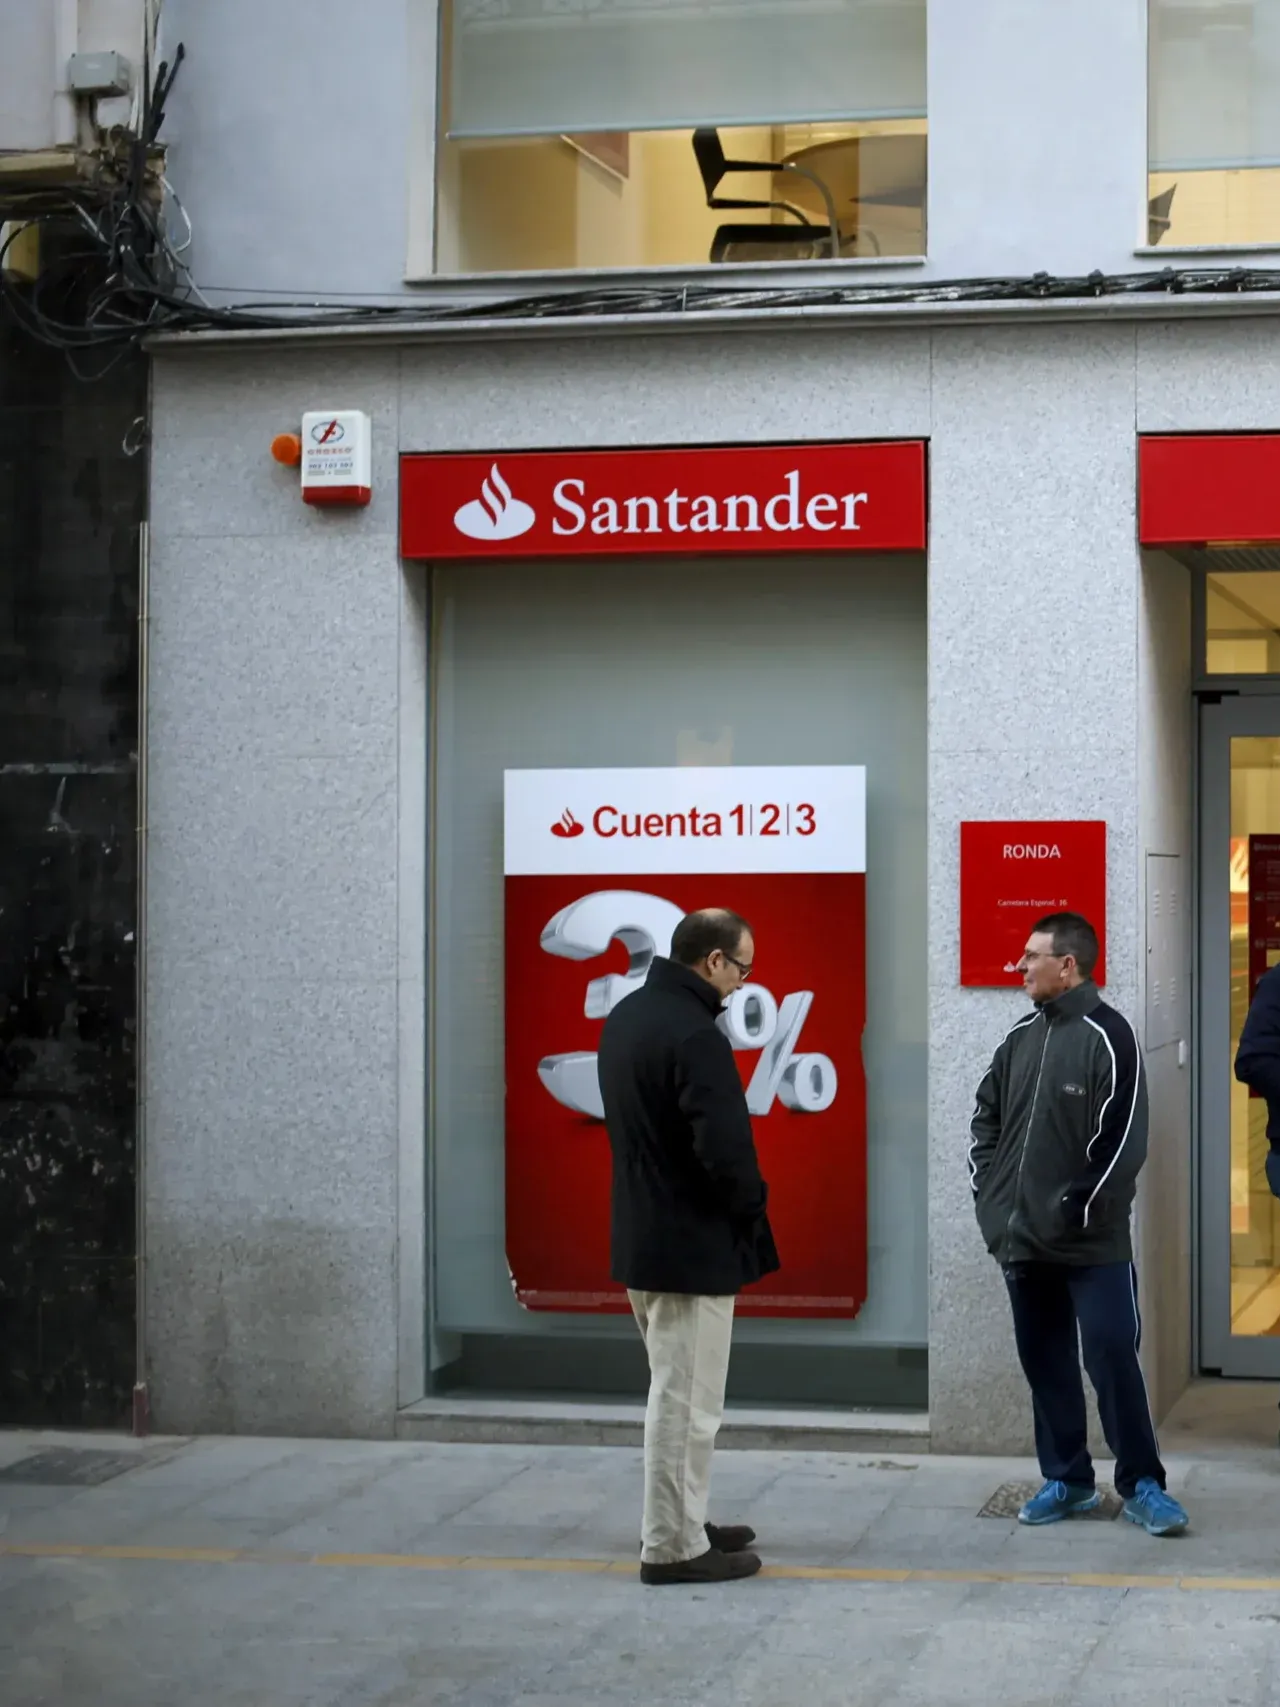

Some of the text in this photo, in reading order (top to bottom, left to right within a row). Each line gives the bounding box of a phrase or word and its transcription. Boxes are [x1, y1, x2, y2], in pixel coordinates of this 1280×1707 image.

[552, 470, 868, 535] Santander
[593, 805, 722, 838] Cuenta
[1003, 845, 1061, 859] RONDA
